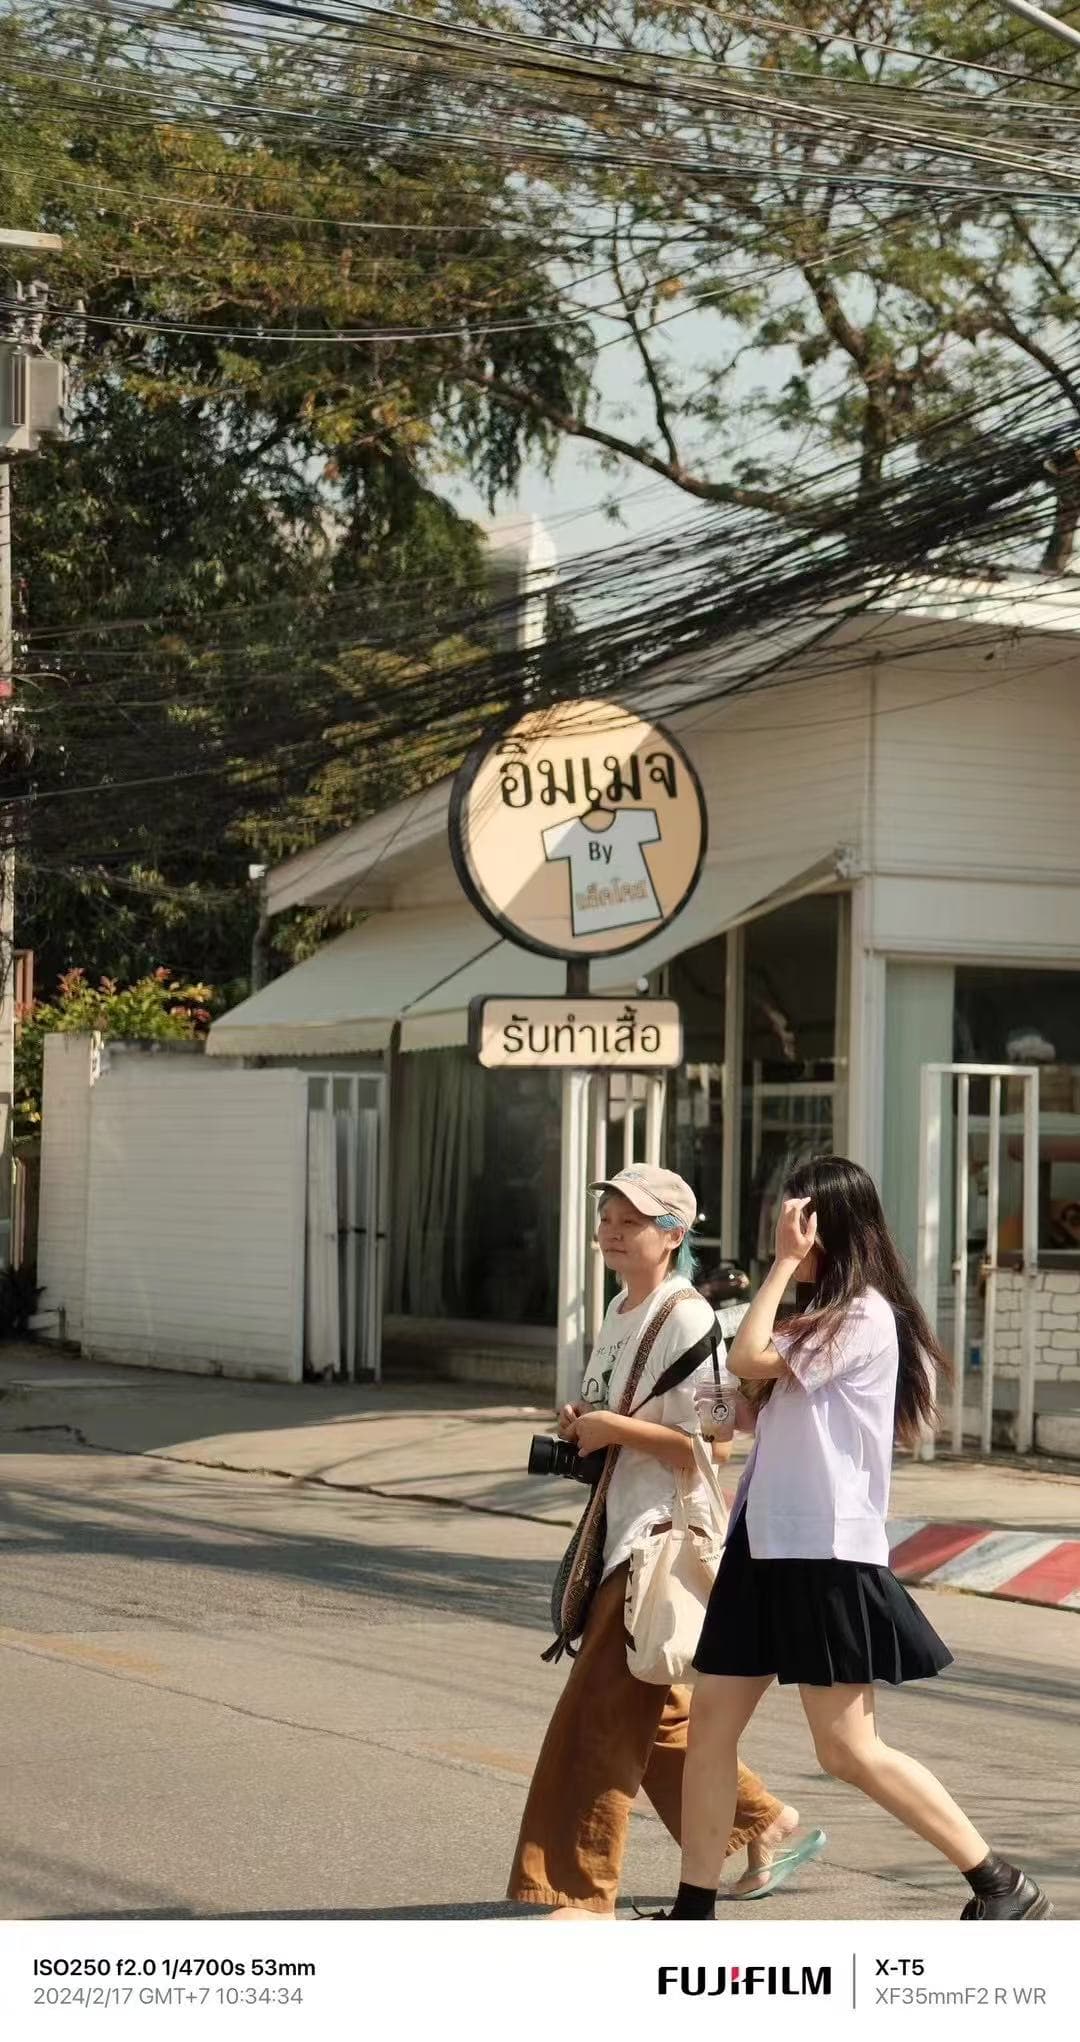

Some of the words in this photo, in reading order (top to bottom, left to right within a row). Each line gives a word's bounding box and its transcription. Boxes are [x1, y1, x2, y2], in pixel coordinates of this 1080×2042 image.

[588, 841, 613, 865] By
[503, 1004, 661, 1054] รับทำเสื้อ
